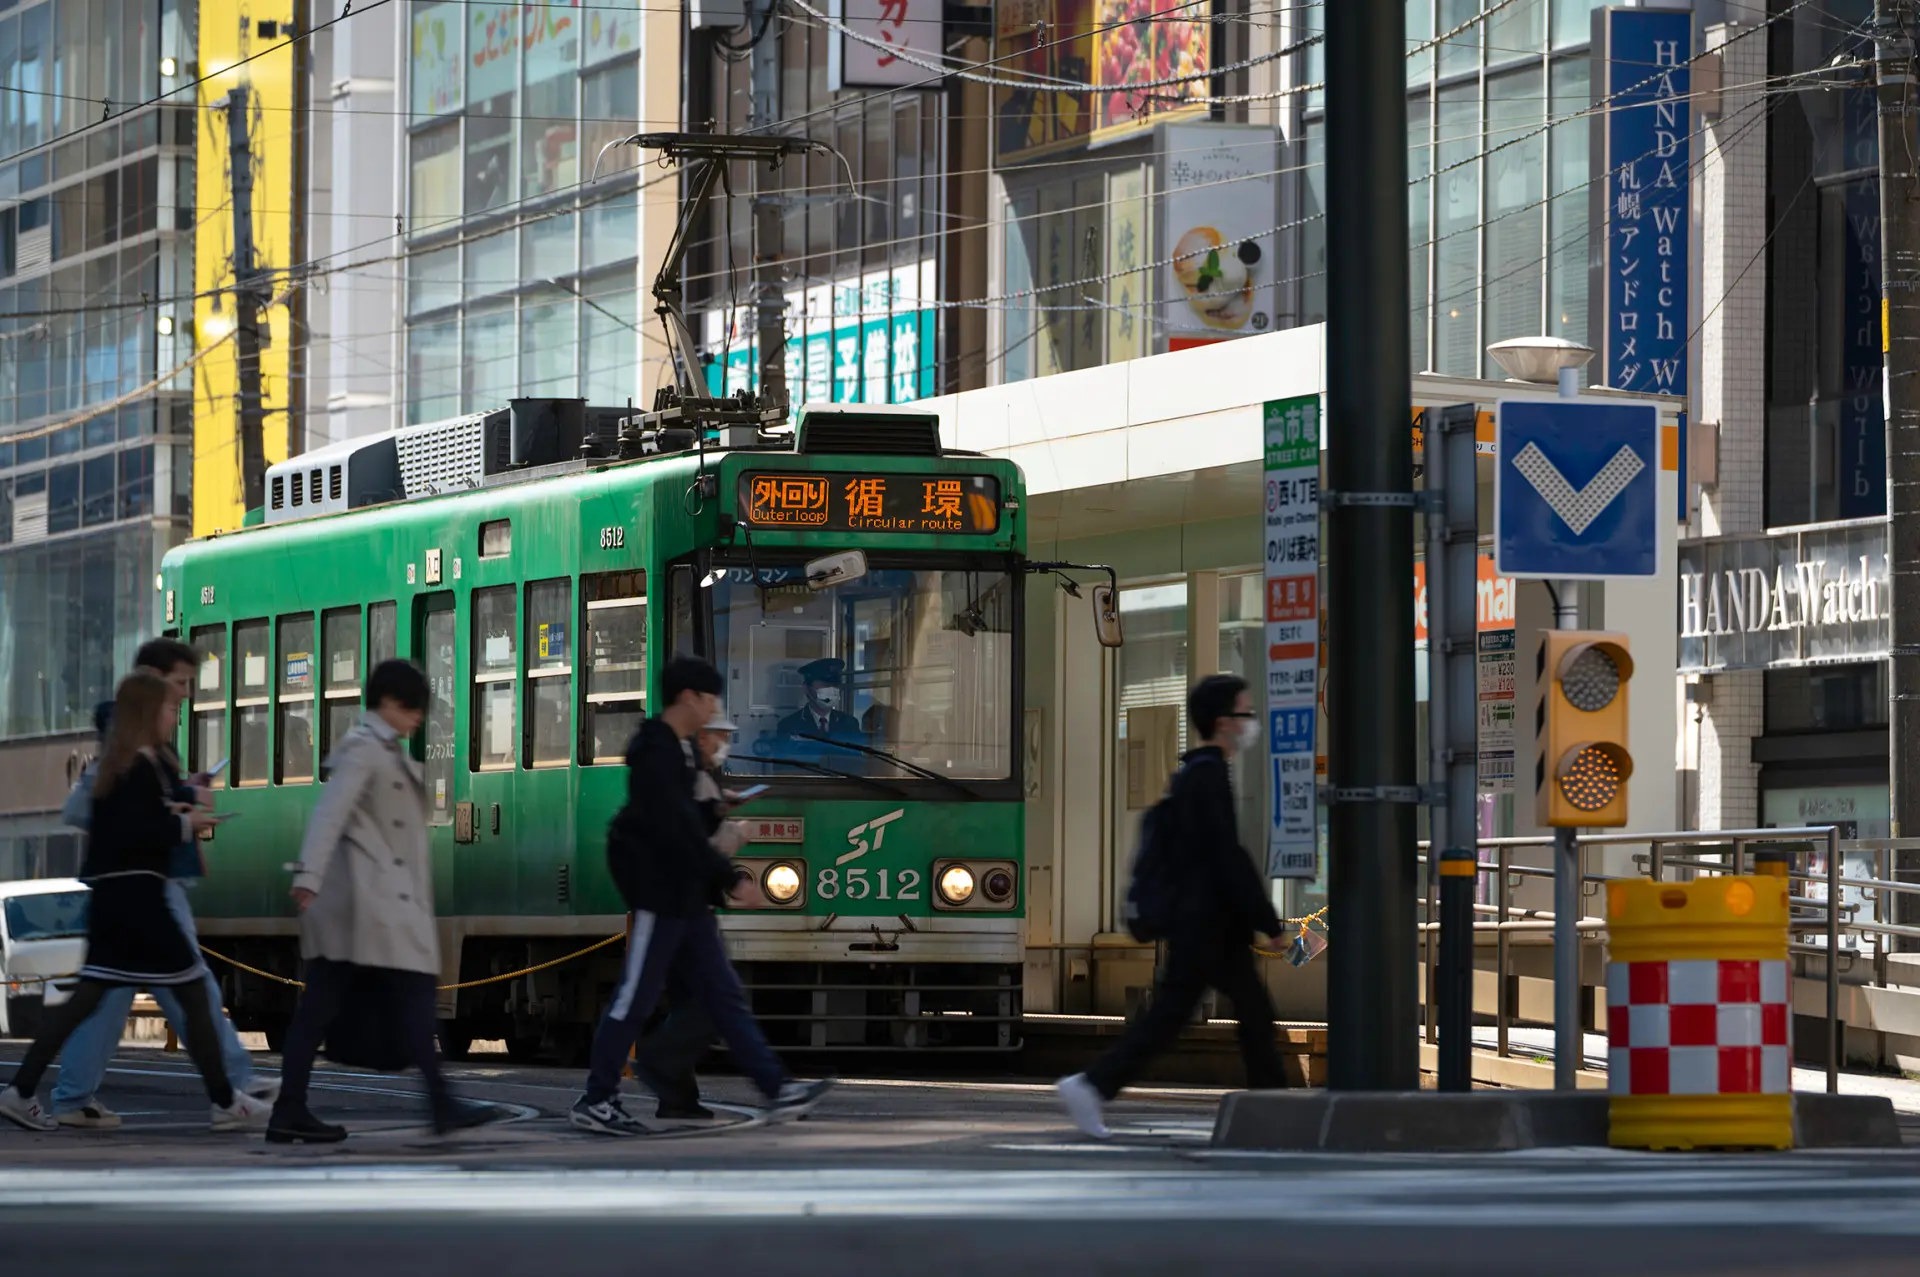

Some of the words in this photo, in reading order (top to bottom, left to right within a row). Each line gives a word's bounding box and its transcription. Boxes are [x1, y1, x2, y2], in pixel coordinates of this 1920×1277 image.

[1653, 40, 1679, 188] HANDA
[1617, 162, 1641, 389] 札幌アンドロメダ
[1652, 207, 1681, 340] Watch
[1285, 404, 1318, 446] 市電
[1267, 449, 1297, 465] STREET
[1300, 446, 1317, 461] CAR
[754, 480, 825, 508] 外回り
[845, 479, 963, 518] 循環
[1280, 477, 1318, 506] 西4丁目
[752, 509, 792, 522] Outer
[795, 509, 825, 523] loop
[848, 515, 915, 529] Circular
[921, 518, 963, 530] route
[600, 527, 624, 549] 8512
[1267, 534, 1316, 563] のりば案内
[427, 556, 439, 575] 入口
[726, 568, 788, 583] ワンマン
[1681, 565, 1791, 638] HANDA
[1795, 555, 1879, 628] Watch
[1498, 662, 1515, 676] ¥230
[835, 808, 904, 867] ST
[816, 868, 921, 900] 8512
